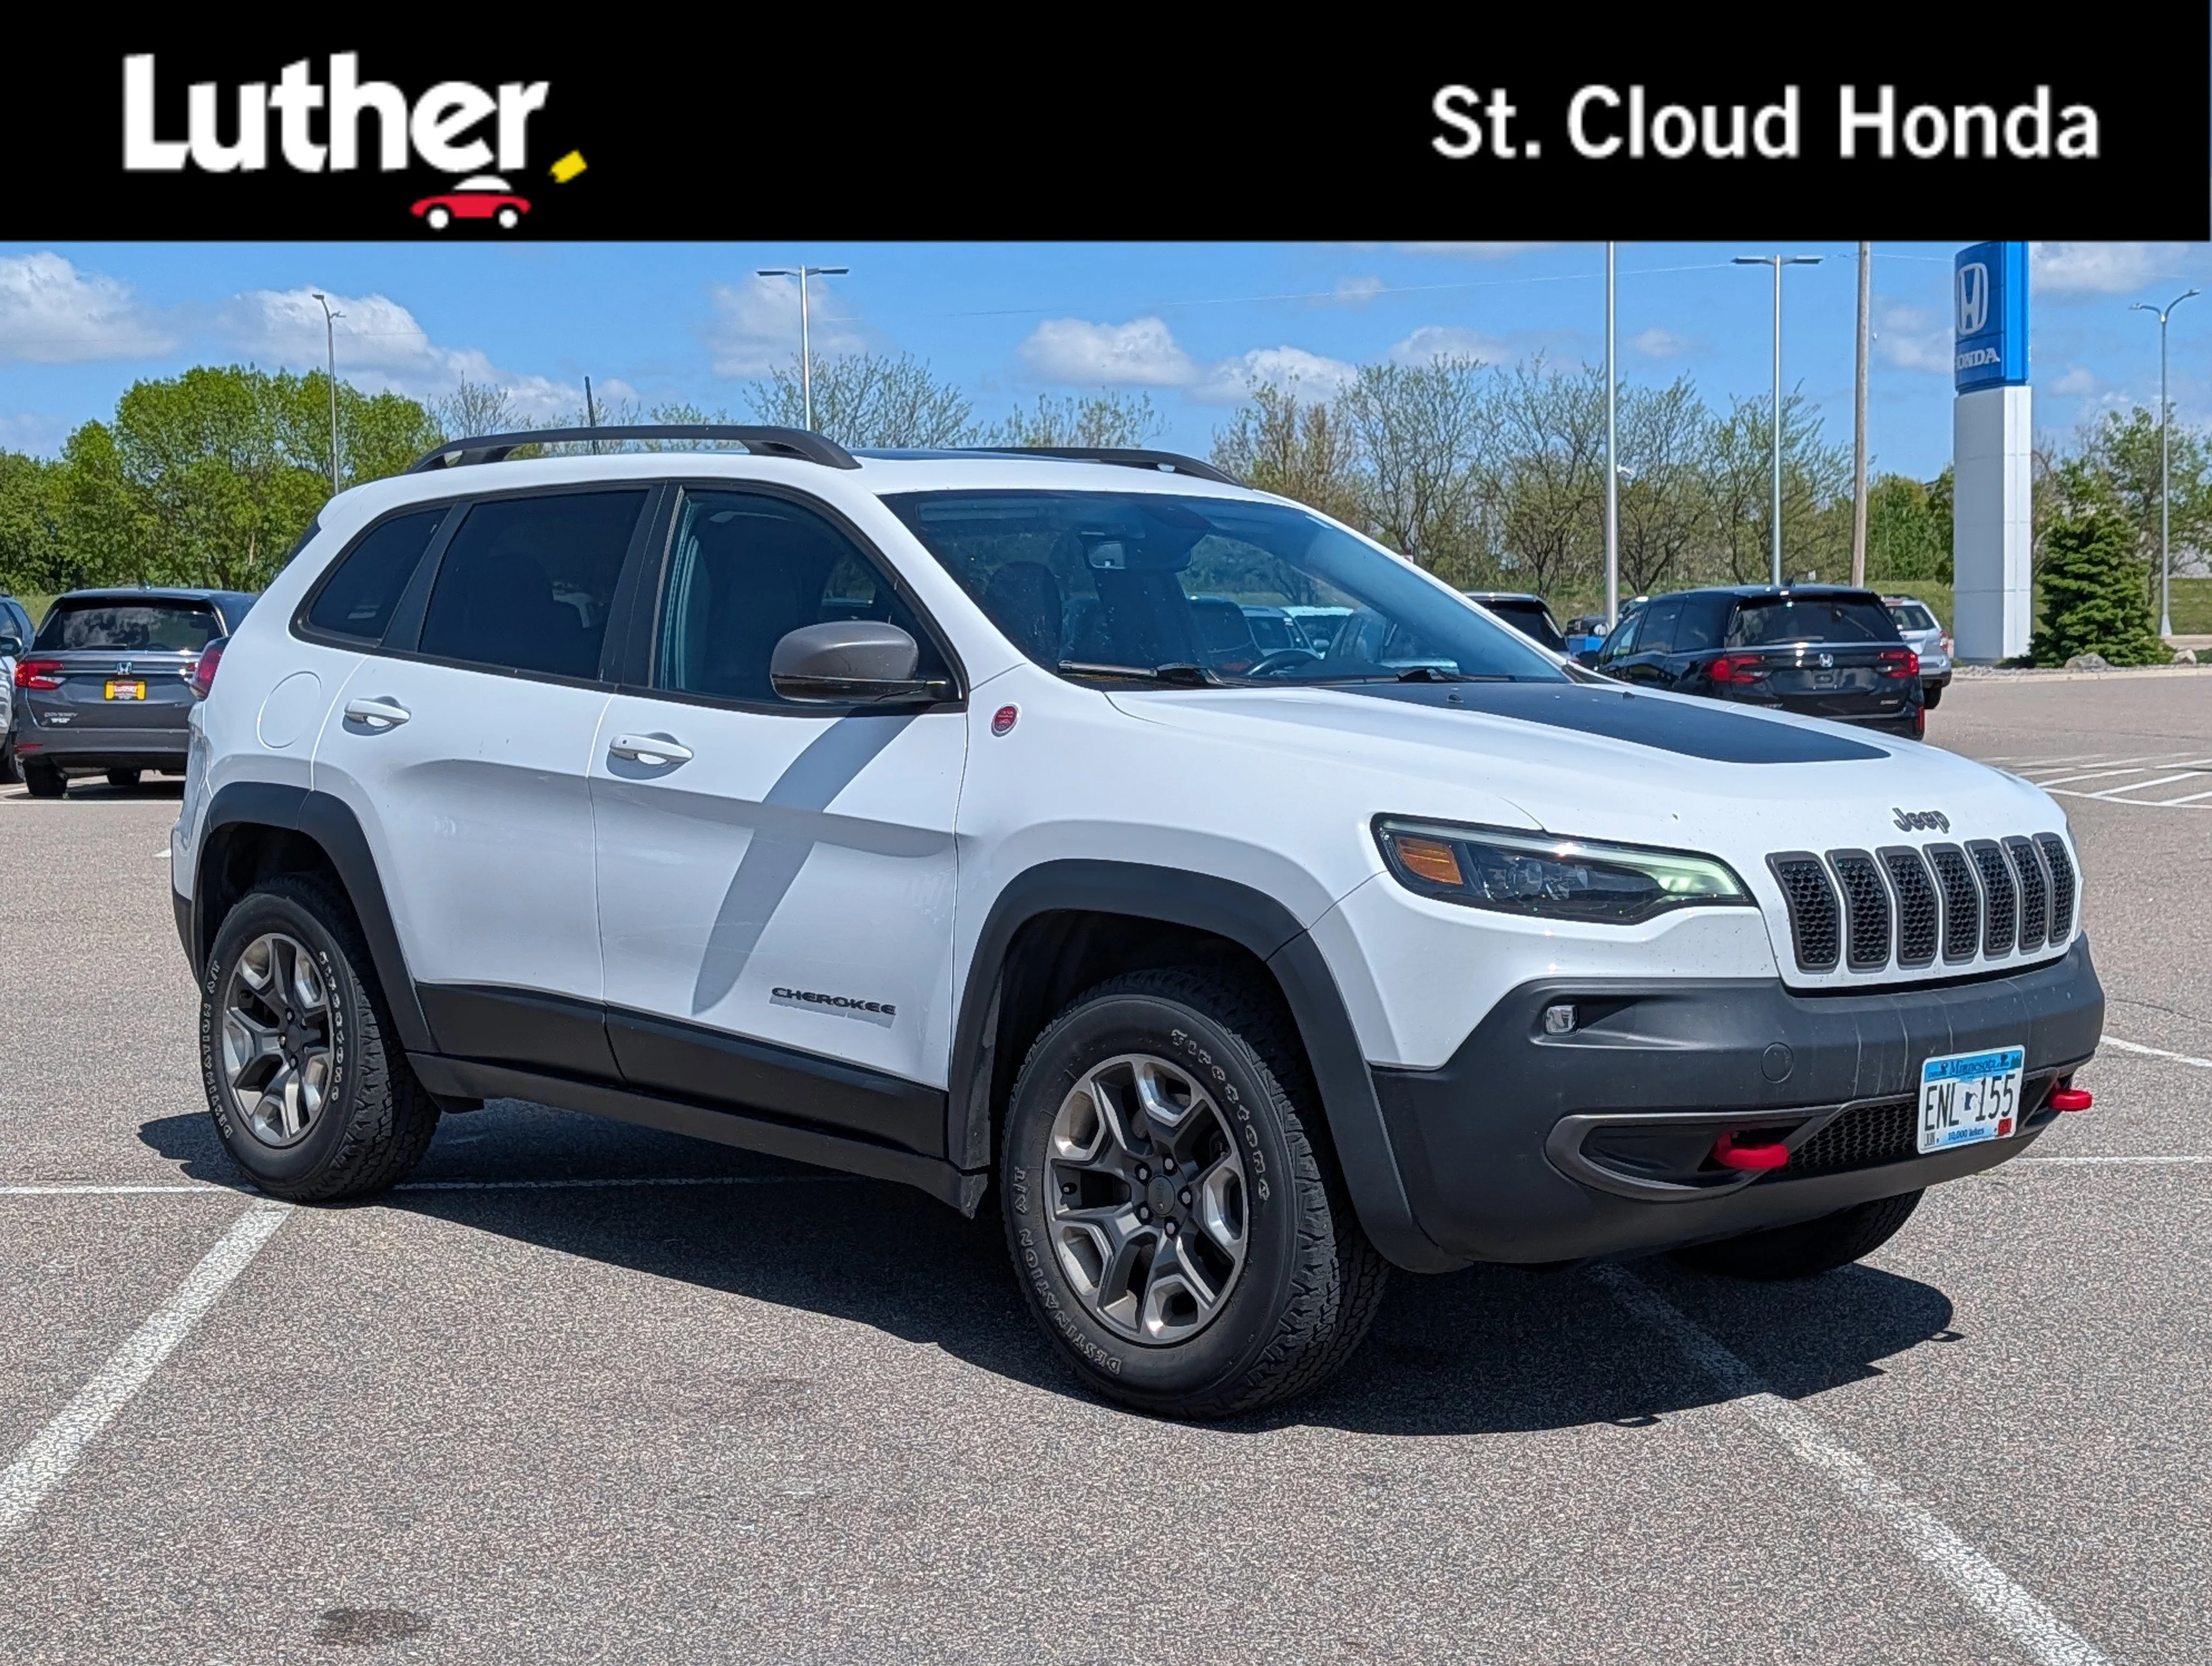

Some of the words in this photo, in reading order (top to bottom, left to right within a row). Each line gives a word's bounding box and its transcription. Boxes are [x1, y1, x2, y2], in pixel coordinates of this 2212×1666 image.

[1955, 347, 2001, 371] ONDA
[1892, 807, 1951, 835] Jeep
[771, 987, 897, 1016] CHEROKEE
[1924, 1082, 1959, 1131] ENL
[1975, 1073, 2016, 1122] 155
[1013, 1166, 1027, 1214] A/T
[1019, 1227, 1122, 1377] DESTINATION
